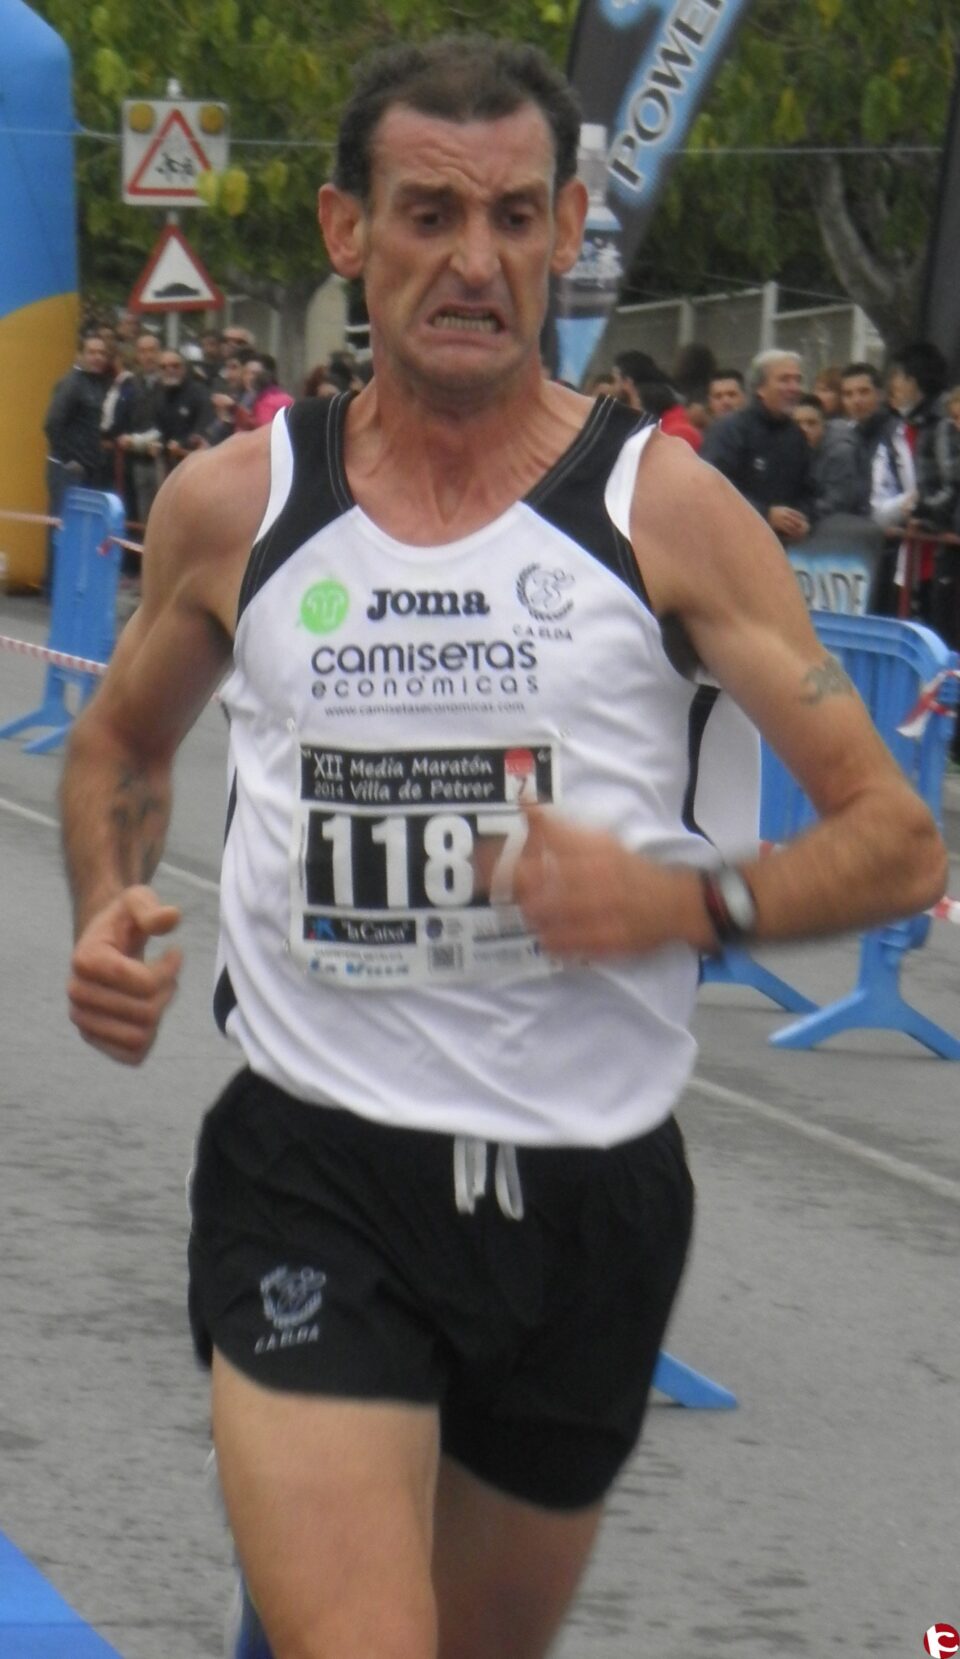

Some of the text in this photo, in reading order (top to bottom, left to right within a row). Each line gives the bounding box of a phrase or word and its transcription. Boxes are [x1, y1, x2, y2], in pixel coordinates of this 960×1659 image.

[608, 0, 727, 192] POWE
[366, 588, 490, 621] Joma
[311, 640, 537, 676] camisetas
[350, 758, 403, 778] Media
[411, 755, 493, 777] Maratón
[349, 780, 390, 801] Villa
[398, 779, 422, 800] de
[430, 780, 494, 800] Petrer
[321, 814, 528, 907] 1187
